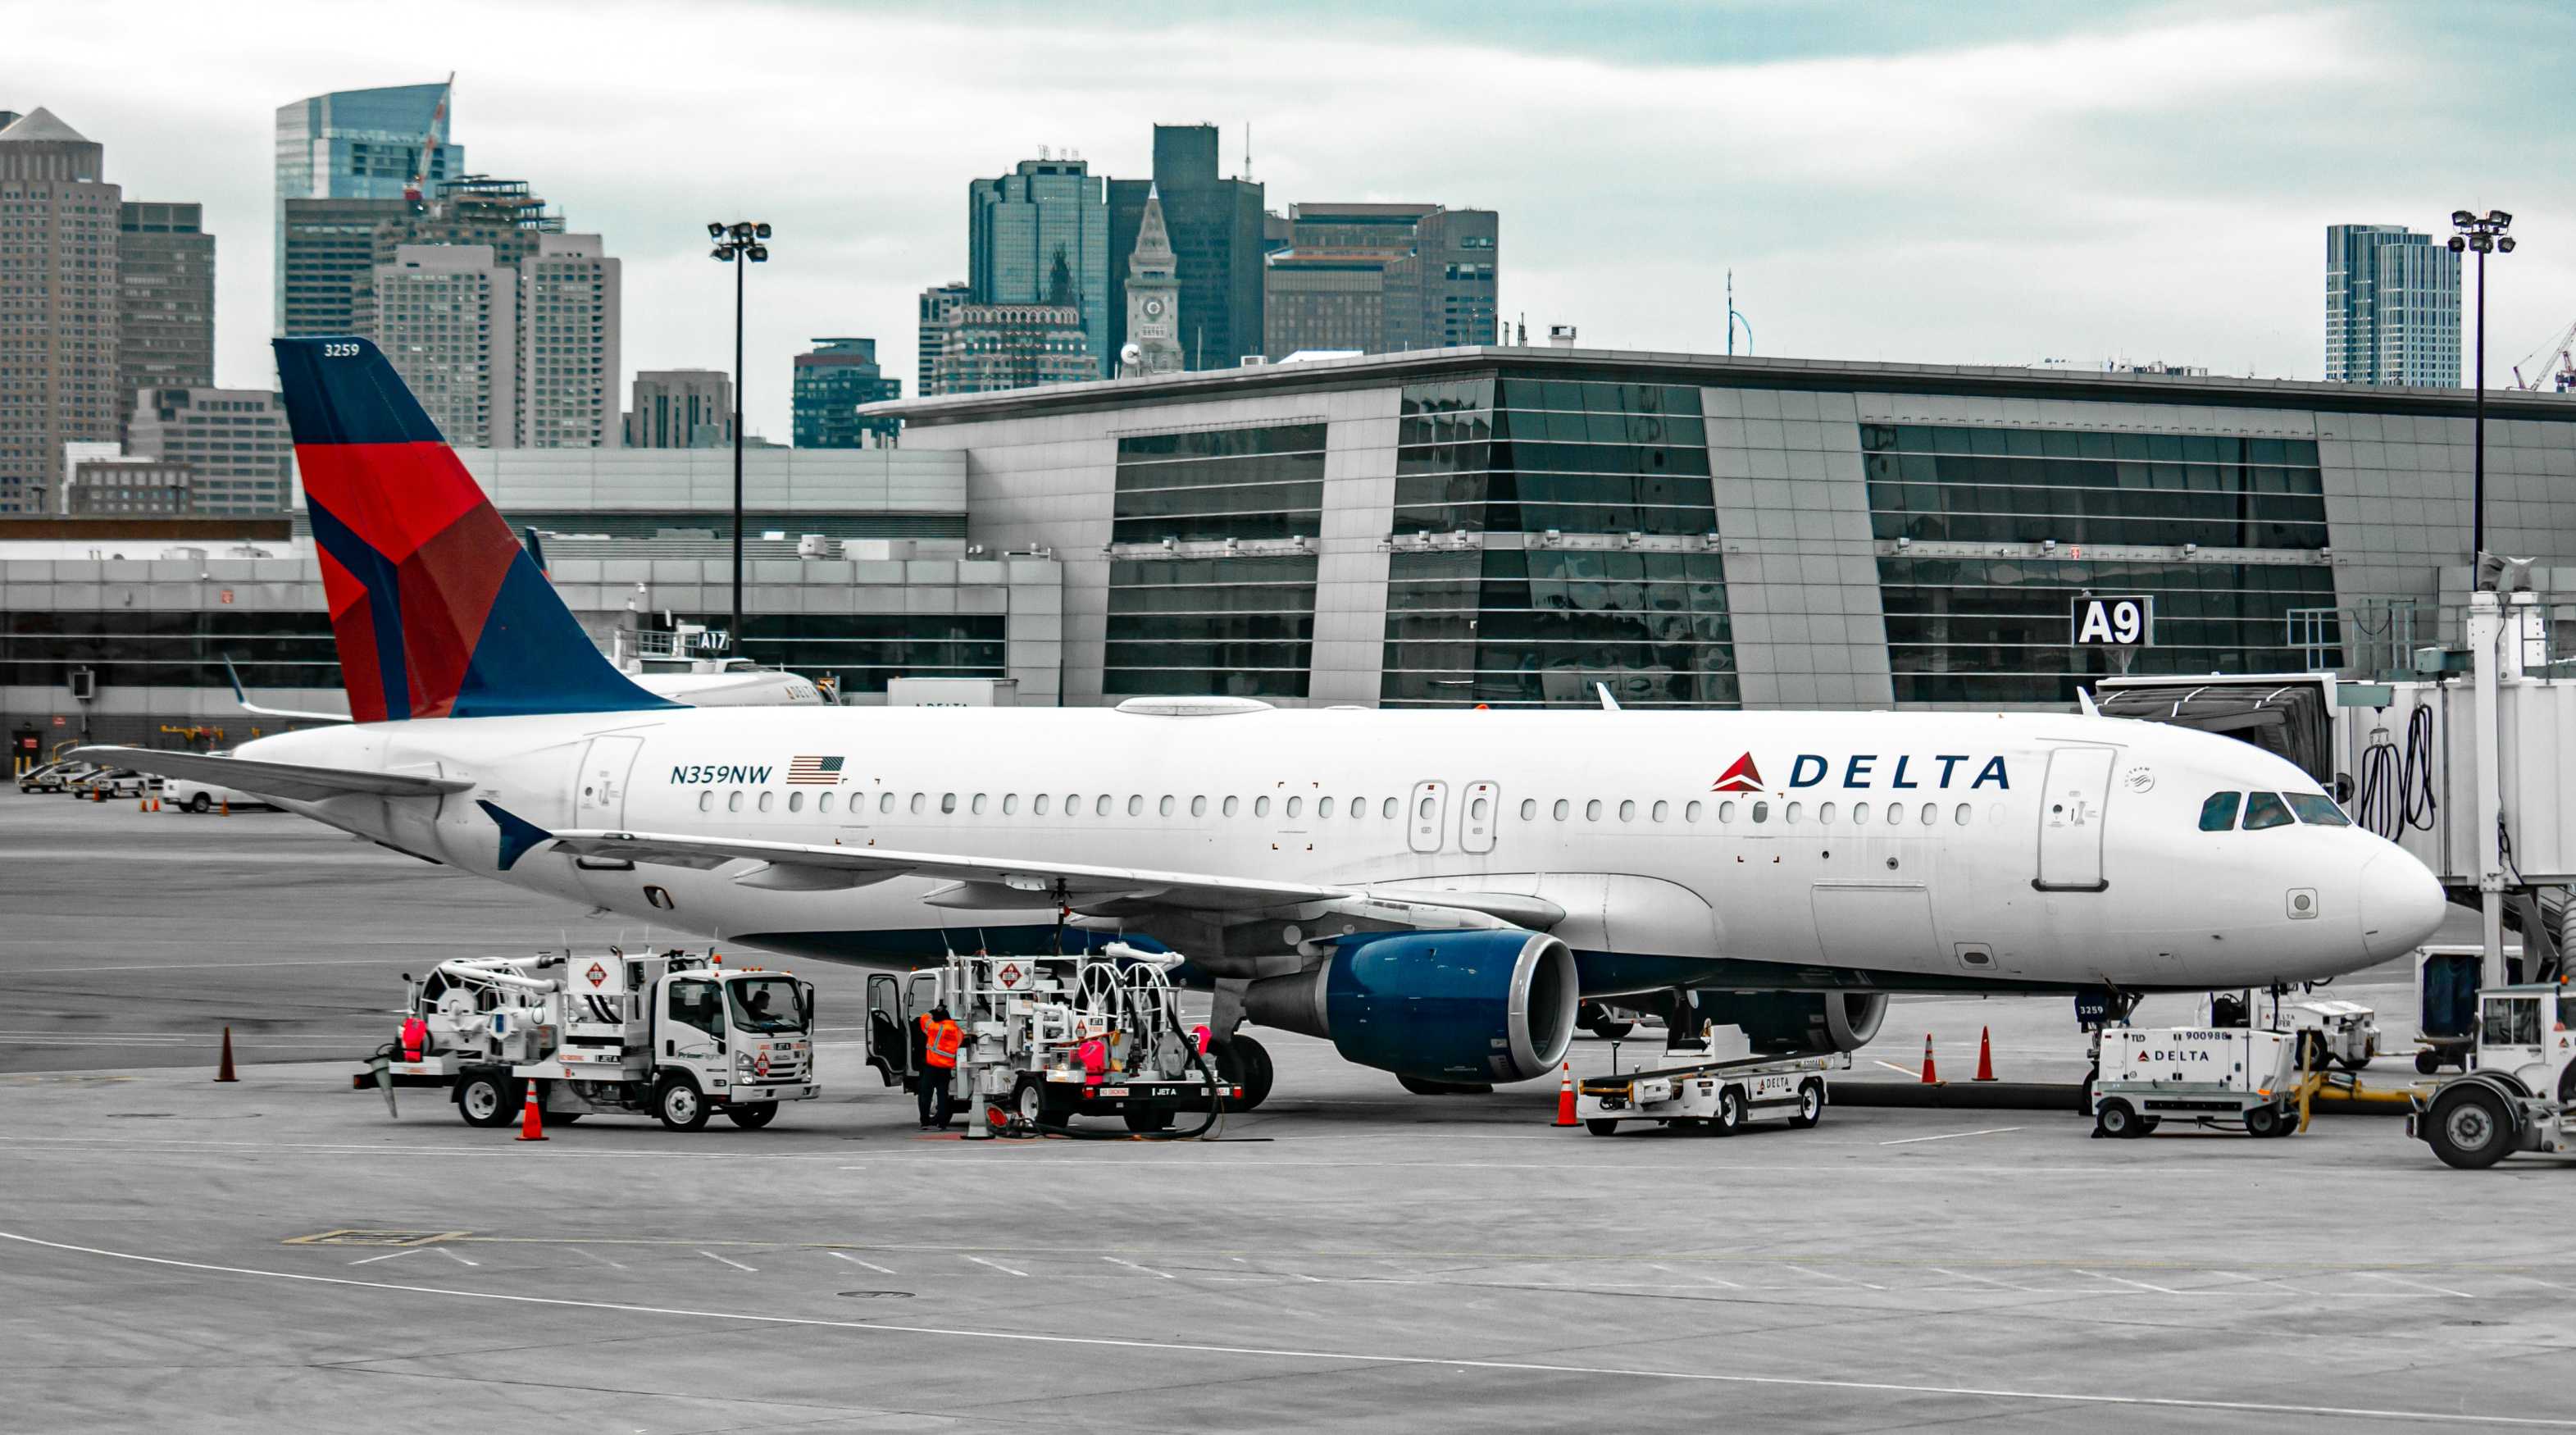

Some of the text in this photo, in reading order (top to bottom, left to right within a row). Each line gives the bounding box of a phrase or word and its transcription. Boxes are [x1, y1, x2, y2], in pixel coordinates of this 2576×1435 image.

[325, 344, 360, 357] 3259
[2078, 600, 2140, 644] A9
[701, 633, 727, 649] A17
[671, 766, 772, 784] N359NW
[1789, 754, 2009, 790] DELTA
[2080, 1005, 2104, 1014] 3259
[2155, 1050, 2209, 1061] DELTA
[1766, 1077, 1789, 1089] DELTA
